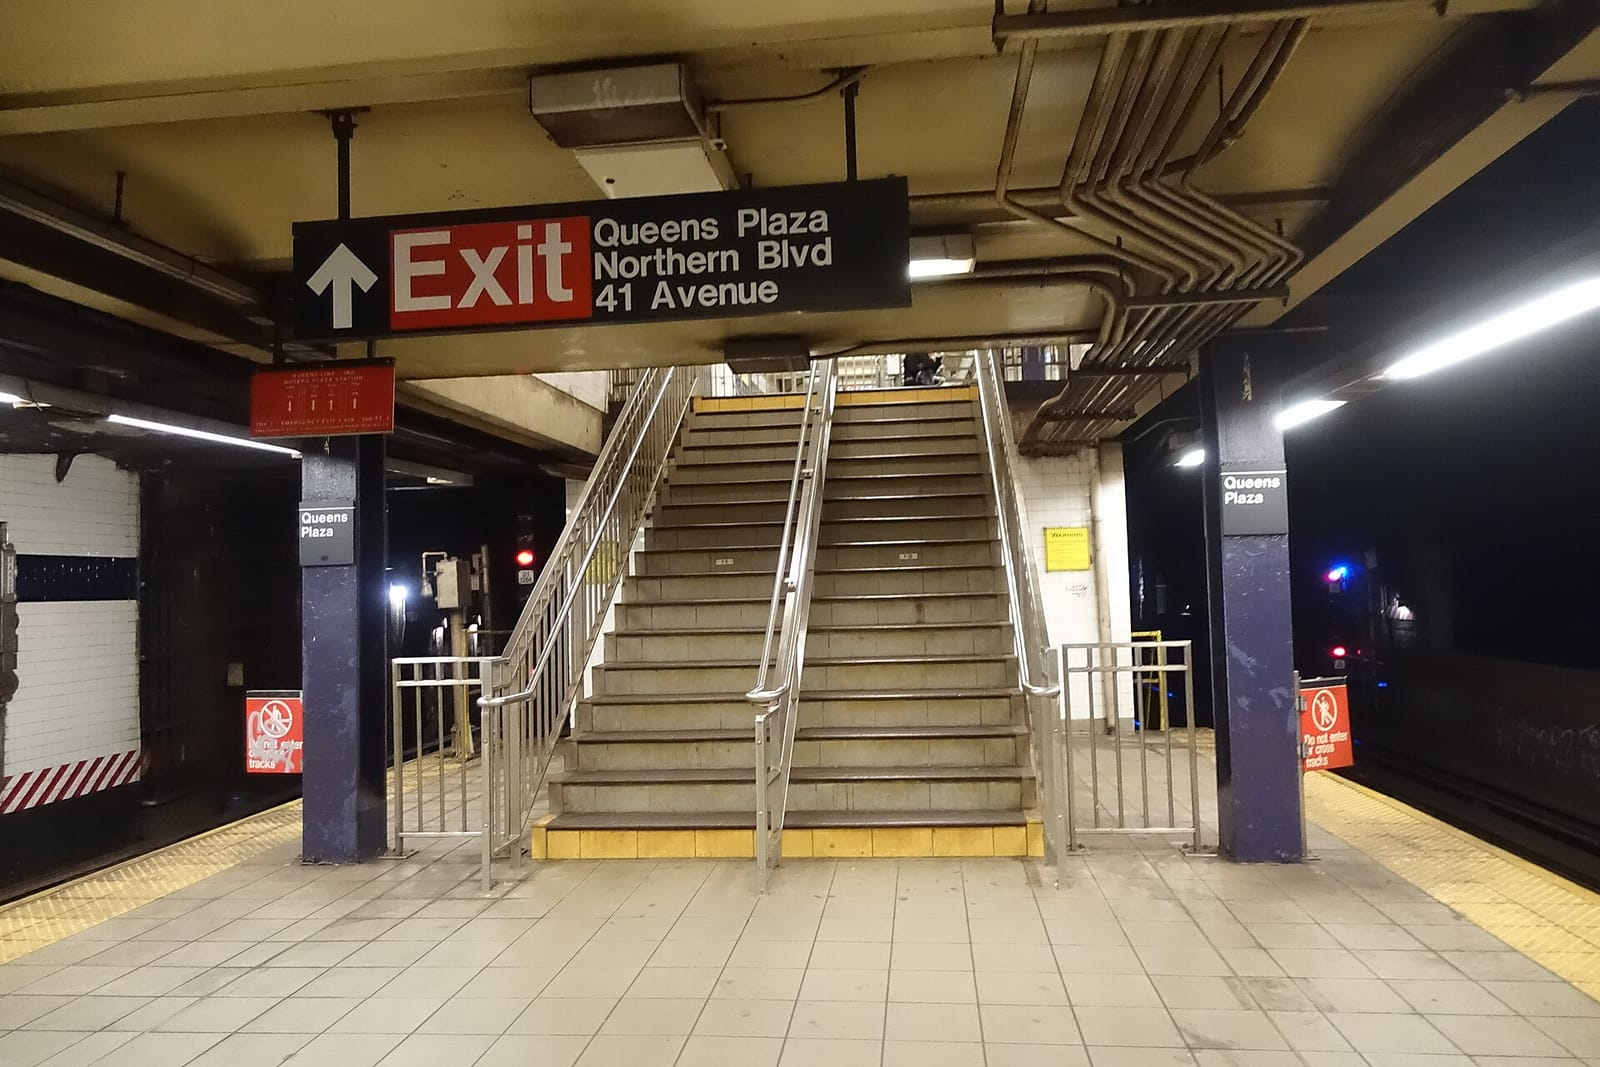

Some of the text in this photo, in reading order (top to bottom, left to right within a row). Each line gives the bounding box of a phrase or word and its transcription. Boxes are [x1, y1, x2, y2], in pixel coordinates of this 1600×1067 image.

[594, 207, 829, 247] Queens Plaza
[594, 236, 832, 280] Northern Blvd
[394, 222, 573, 313] Exit
[595, 280, 779, 312] 41 Avenue
[1224, 476, 1280, 489] Queens
[1224, 491, 1264, 504] Plaza
[301, 512, 348, 524] Queens
[301, 526, 334, 538] Plaza
[1304, 732, 1348, 745] Do not enter
[1315, 744, 1335, 755] cross
[249, 758, 276, 769] tracks
[1306, 755, 1328, 768] tracks
